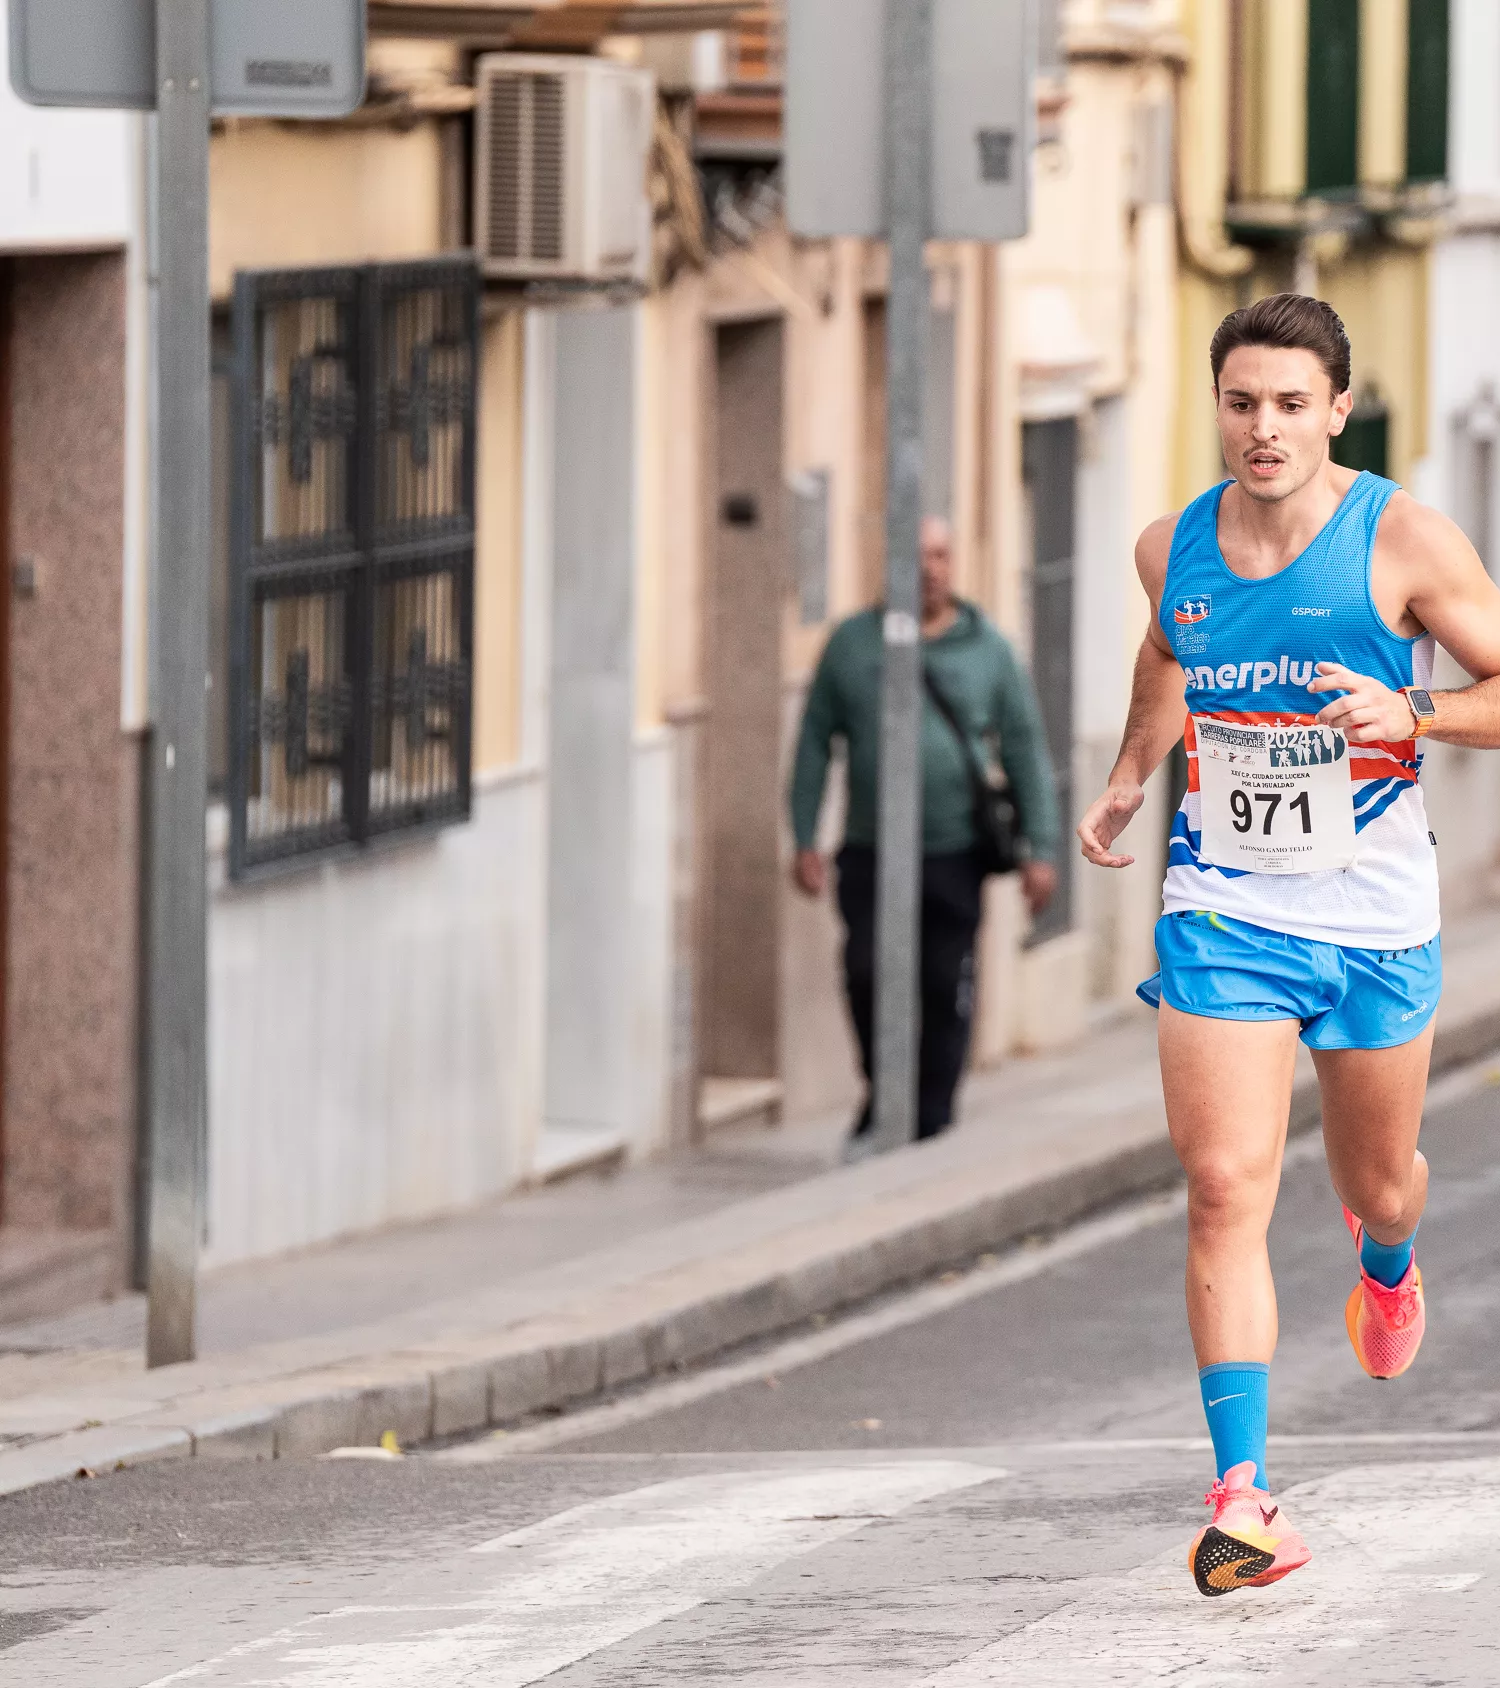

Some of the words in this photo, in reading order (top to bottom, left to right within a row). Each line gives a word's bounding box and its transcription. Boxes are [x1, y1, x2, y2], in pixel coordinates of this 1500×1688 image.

[1291, 607, 1332, 617] GSPORT
[1199, 730, 1229, 743] CARRERAS
[1229, 736, 1267, 749] POPULARES
[1223, 727, 1256, 740] PROVINCIAL
[1267, 730, 1311, 748] 2024
[1285, 772, 1311, 780] LUCENA
[1241, 780, 1252, 788] POR
[1230, 789, 1312, 835] 971
[1239, 844, 1265, 853] ALFONSO
[1266, 846, 1287, 854] GAMO
[1288, 845, 1313, 853] TELLO
[1401, 1000, 1428, 1022] GSPORT
